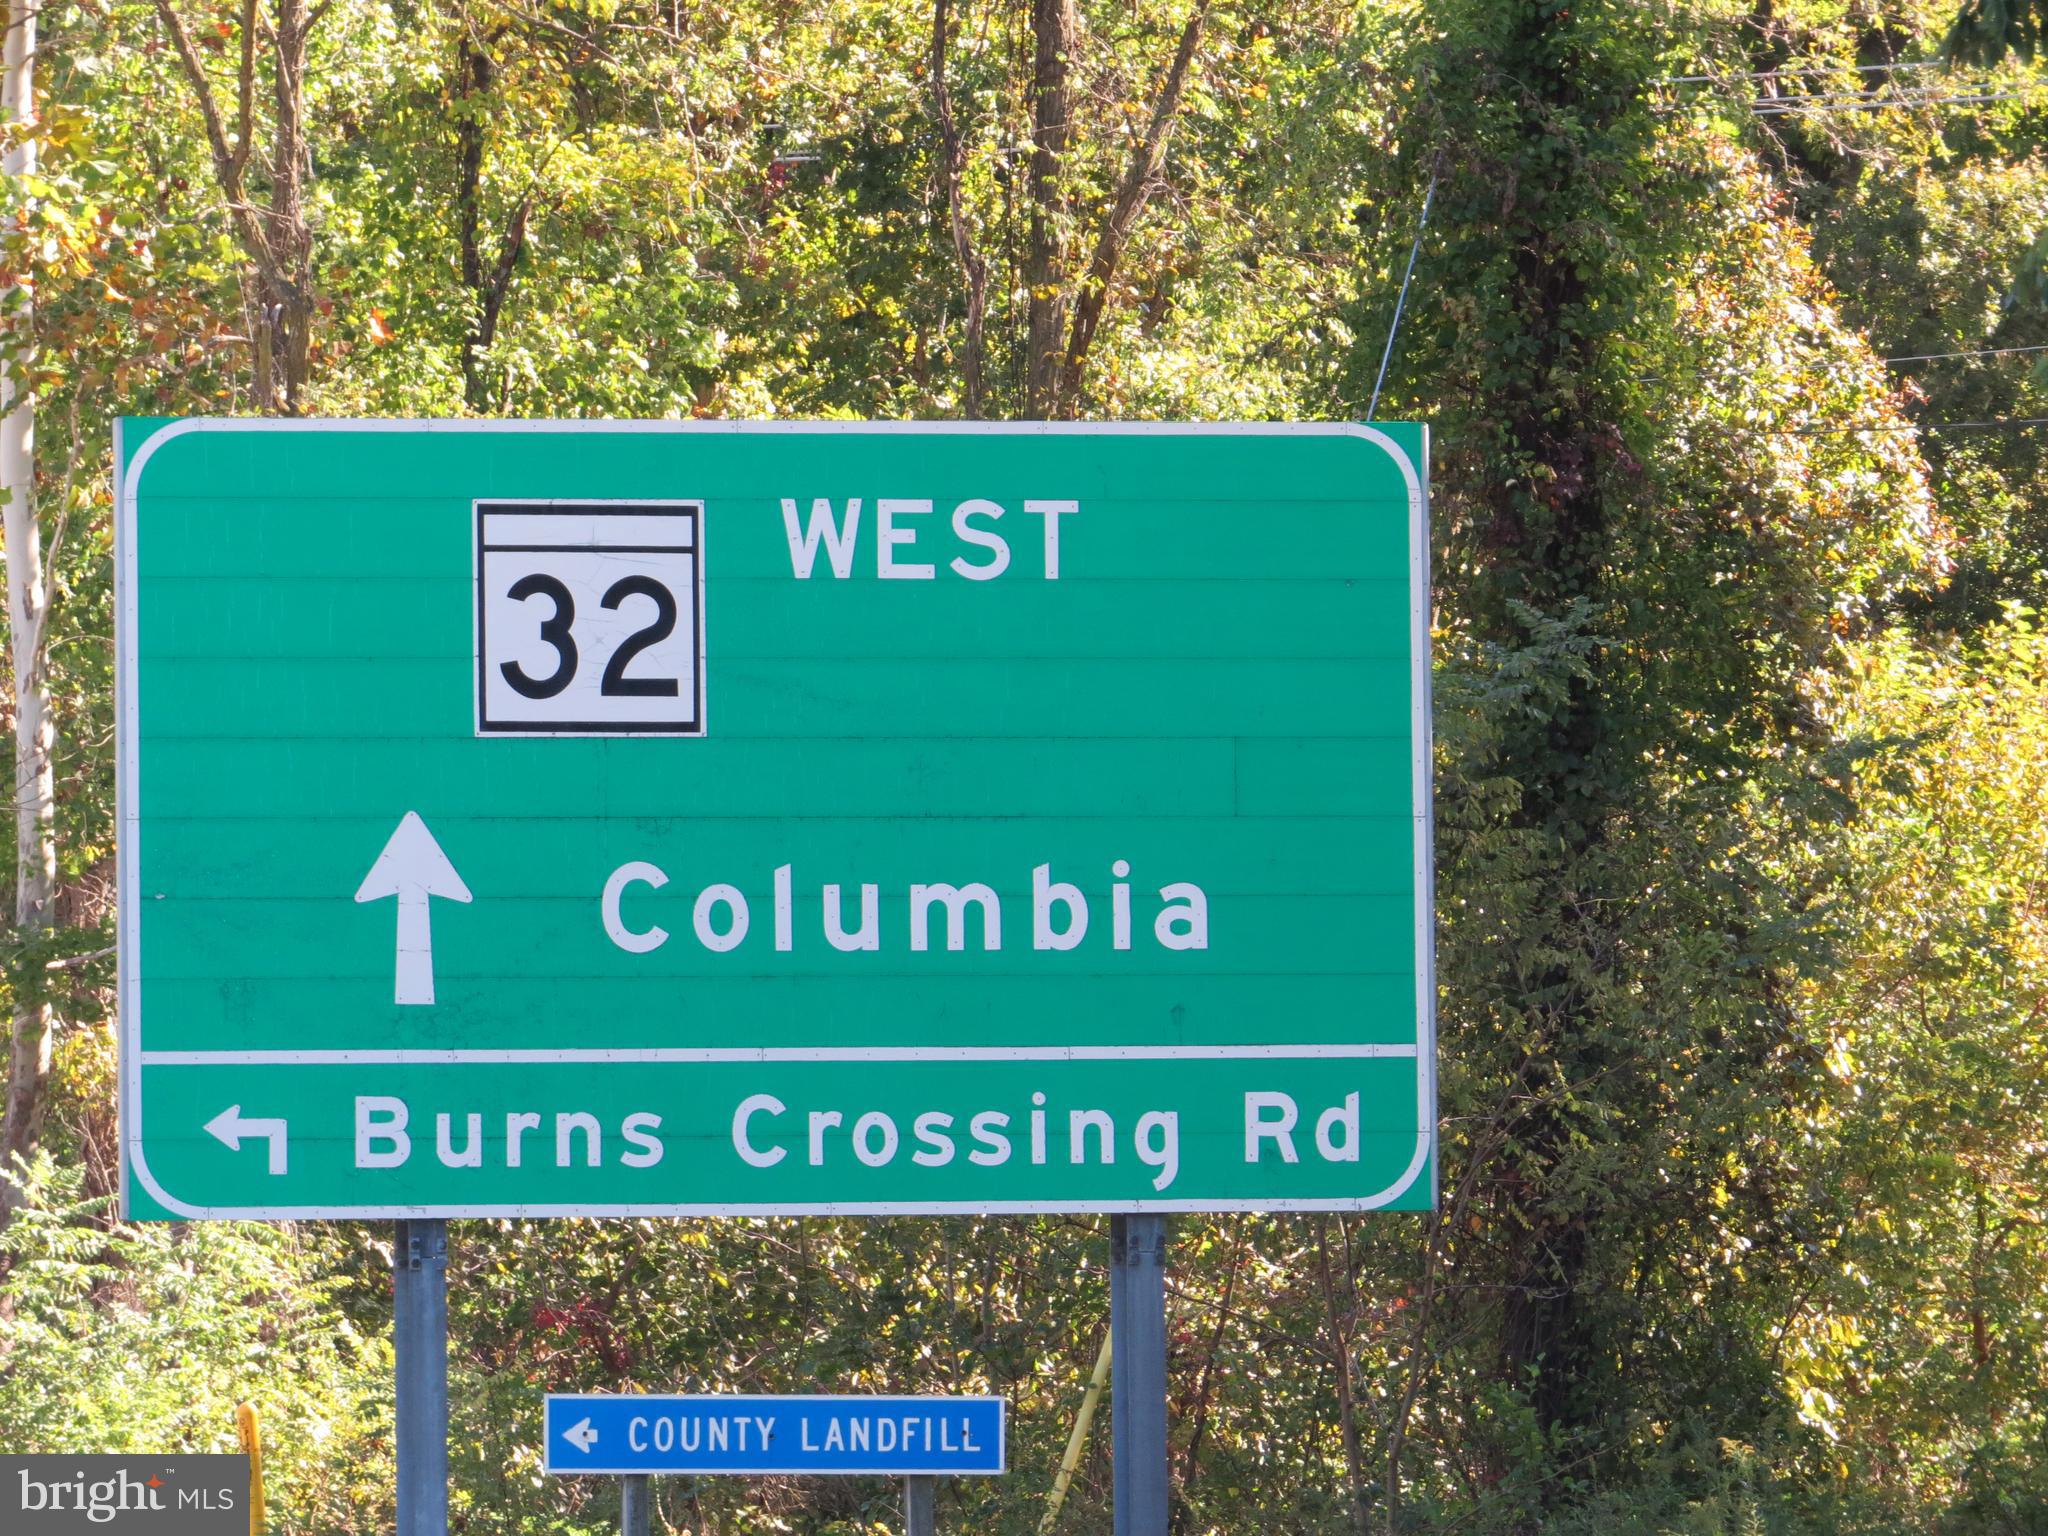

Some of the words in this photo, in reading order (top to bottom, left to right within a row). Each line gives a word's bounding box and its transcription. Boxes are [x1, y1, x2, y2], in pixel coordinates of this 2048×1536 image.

[780, 498, 1079, 580] WEST
[500, 573, 679, 699] 32
[601, 860, 1209, 953] Columbia
[354, 1096, 664, 1168] Burns
[732, 1091, 1180, 1191] Crossing
[1245, 1091, 1360, 1163] Rd
[629, 1417, 775, 1452] COUNTY
[803, 1417, 981, 1452] LANDFILL
